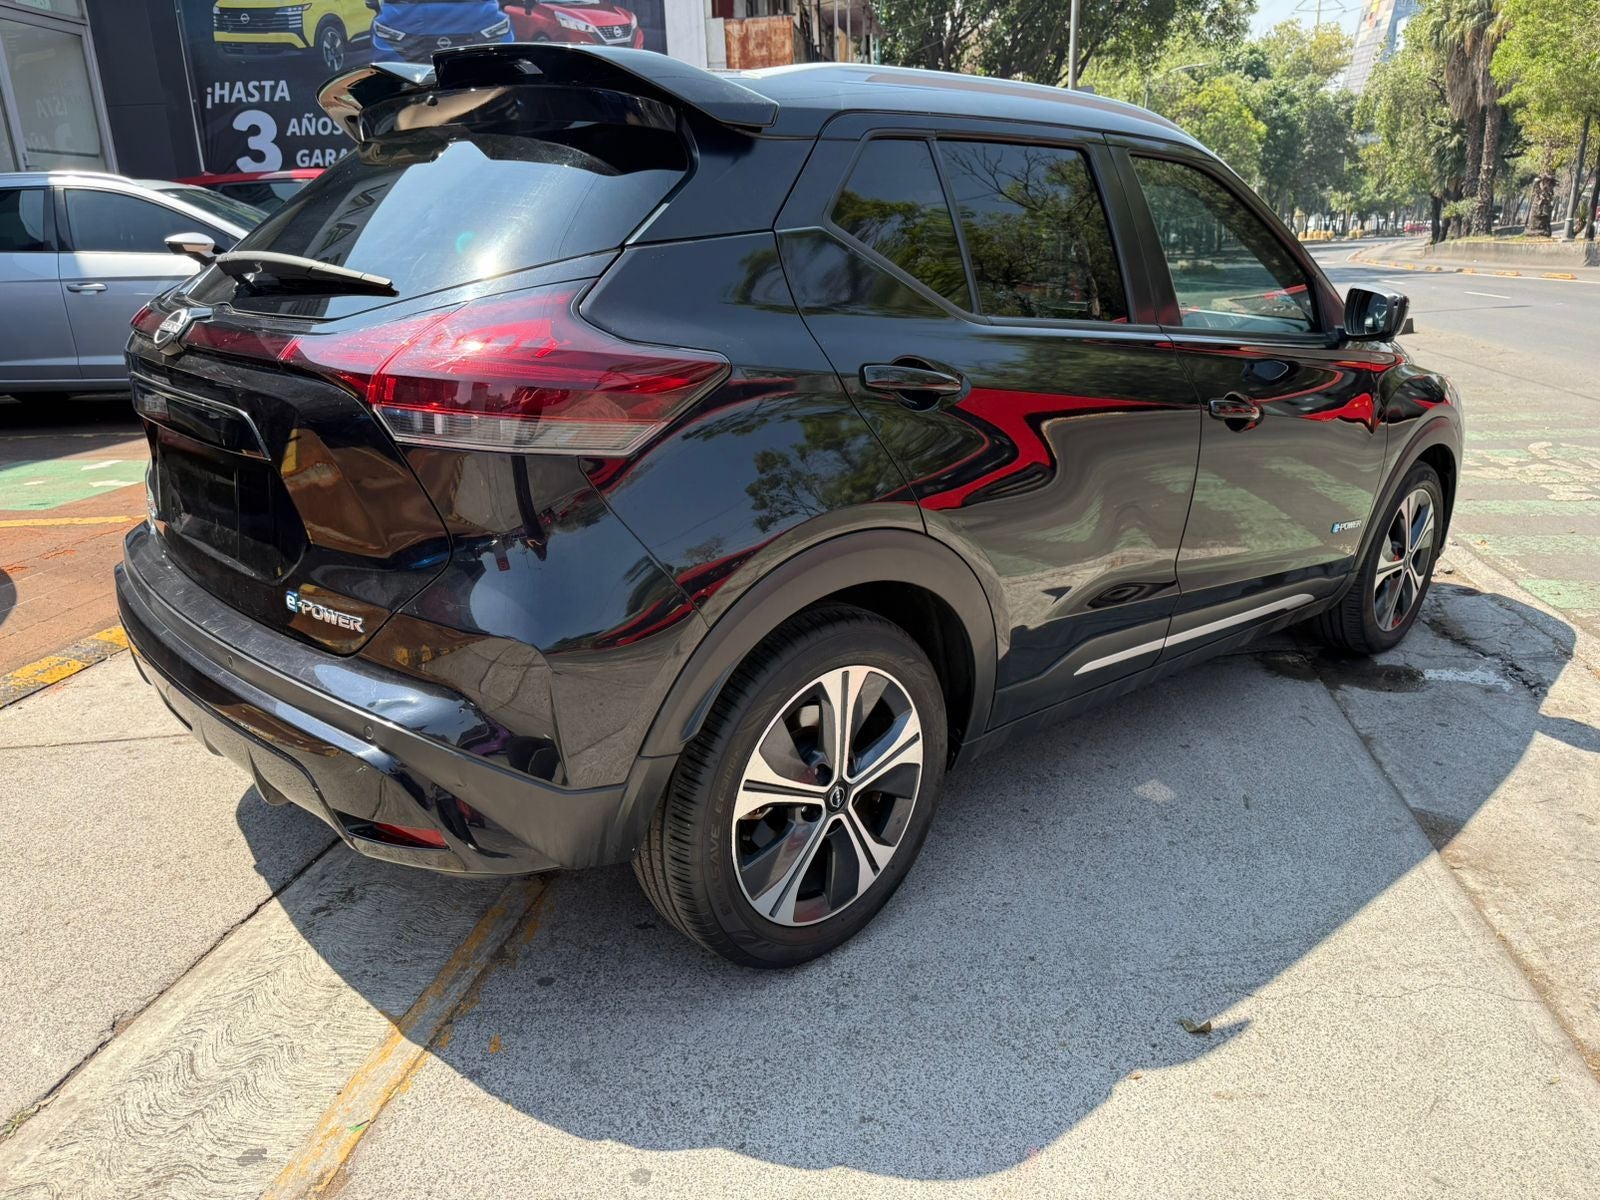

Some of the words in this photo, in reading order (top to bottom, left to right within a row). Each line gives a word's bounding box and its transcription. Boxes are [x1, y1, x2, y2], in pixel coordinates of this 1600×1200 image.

[206, 80, 291, 109] ¡HASTA
[232, 109, 283, 173] 3
[286, 113, 343, 136] AÑOS
[286, 591, 365, 633] e-POWER
